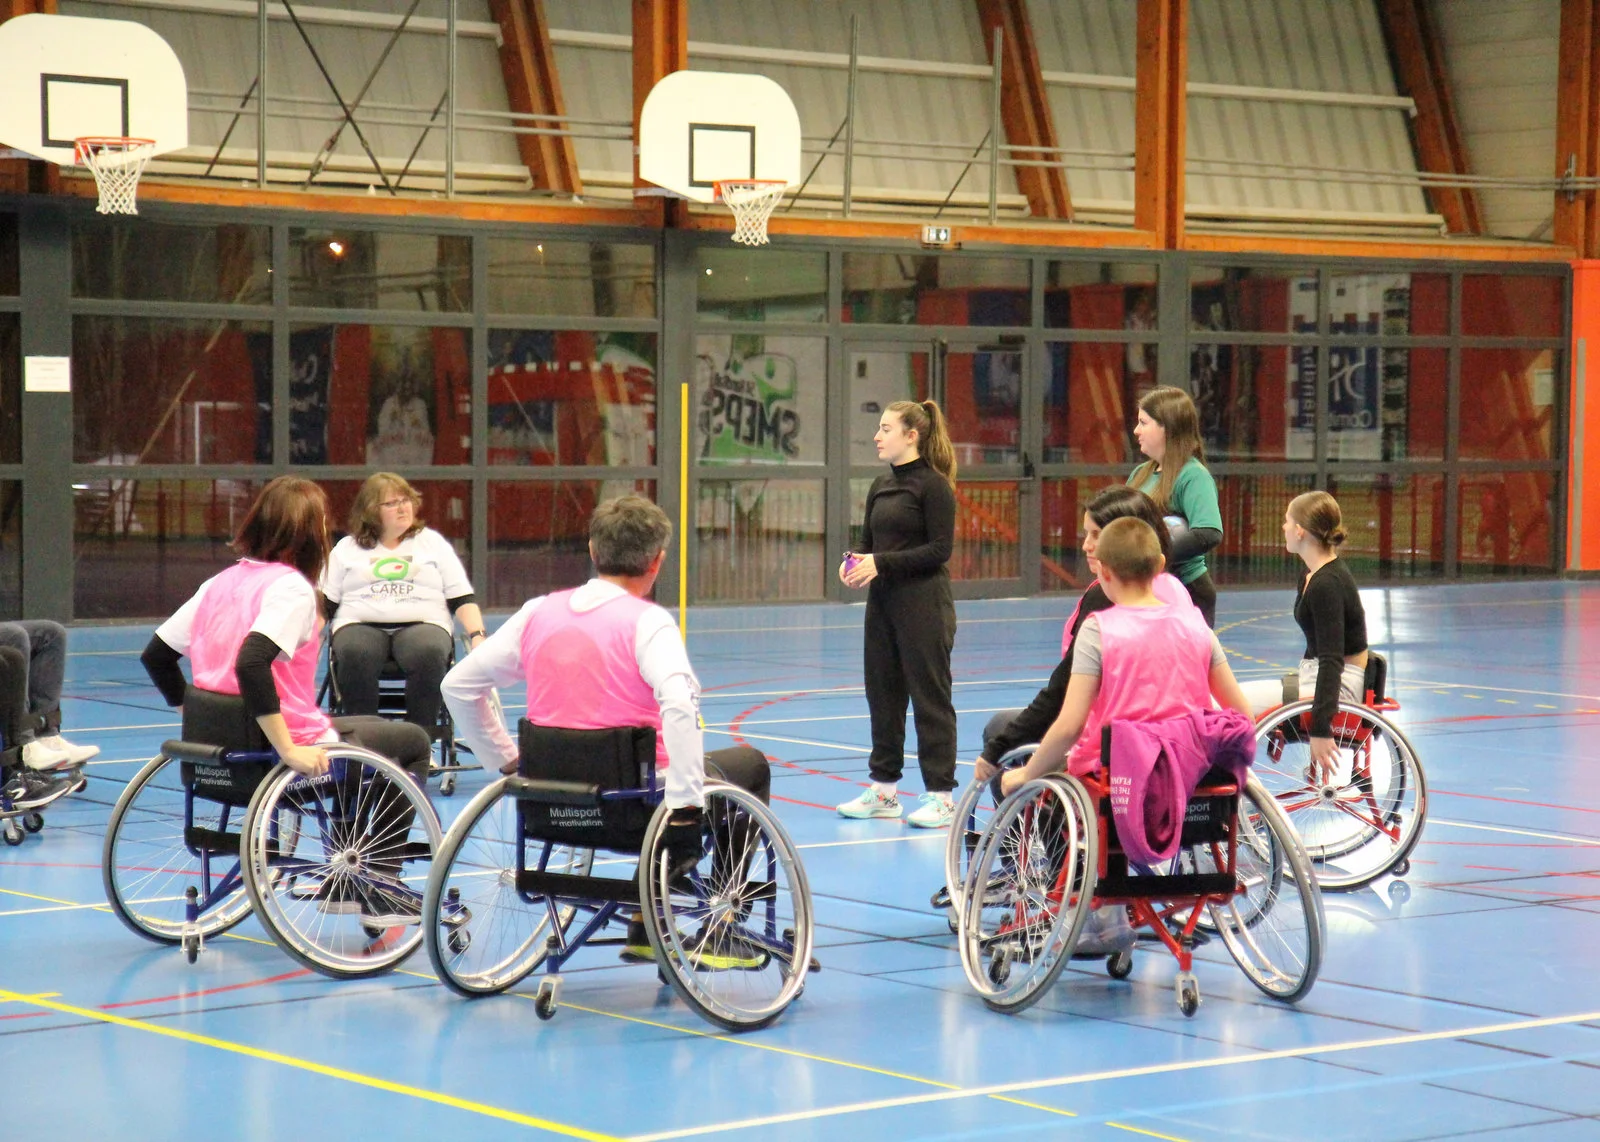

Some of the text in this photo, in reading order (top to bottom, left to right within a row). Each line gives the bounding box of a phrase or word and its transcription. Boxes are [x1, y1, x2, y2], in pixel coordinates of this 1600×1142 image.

[370, 583, 414, 595] CAREP
[194, 765, 231, 778] Multisport
[286, 773, 332, 792] motivation
[549, 807, 602, 819] Multisport
[559, 819, 604, 827] motivation
